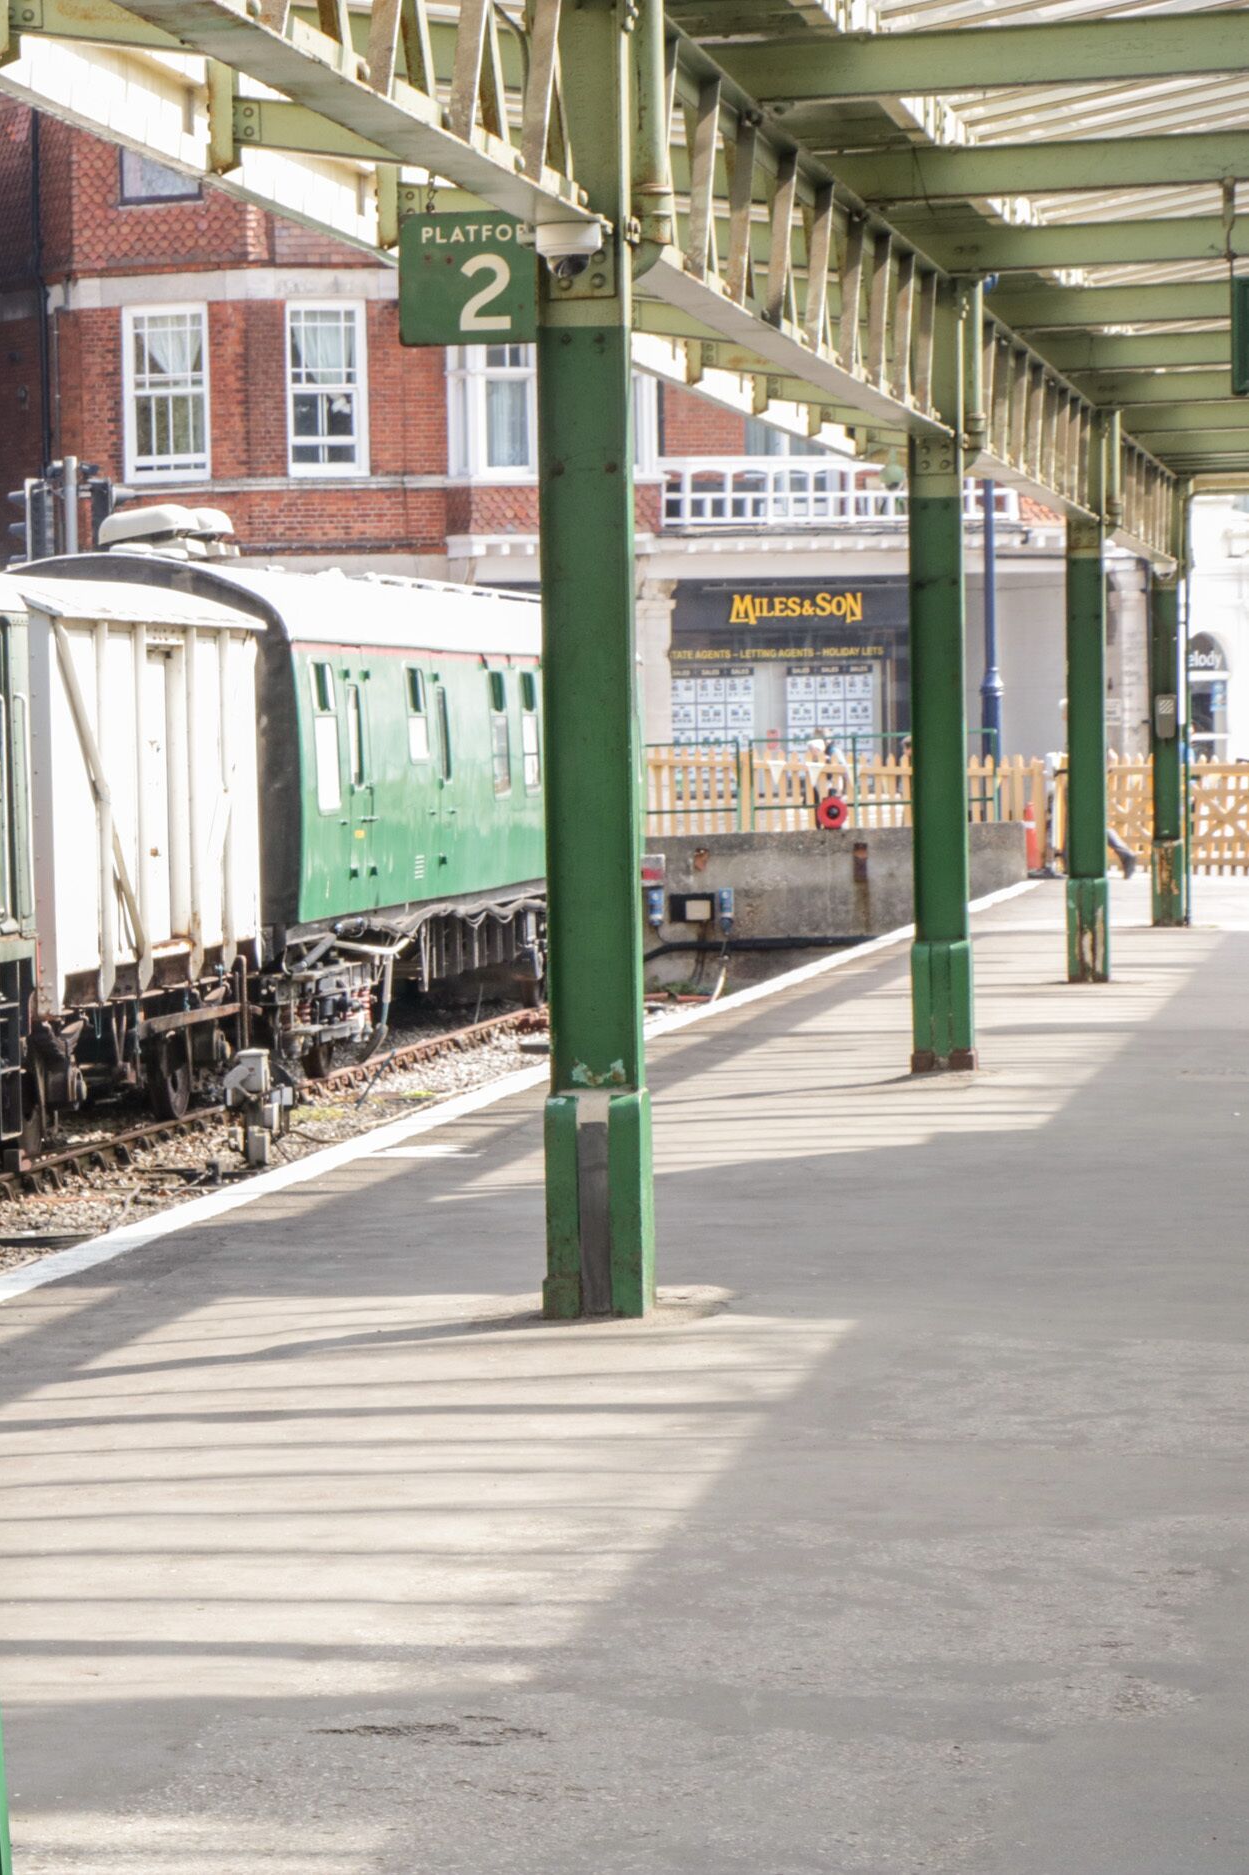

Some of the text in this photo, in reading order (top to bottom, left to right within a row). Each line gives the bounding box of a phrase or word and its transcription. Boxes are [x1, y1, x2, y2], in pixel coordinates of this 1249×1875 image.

[420, 223, 526, 244] PLATFO
[459, 253, 512, 332] 2
[728, 591, 863, 625] MILES&SON
[670, 650, 693, 660] TATE
[695, 649, 731, 660] AGENTS
[740, 648, 776, 659] LETTING
[778, 647, 814, 658] AGENTS
[822, 646, 860, 657] HOLIDAY
[862, 646, 884, 656] LETS
[1188, 649, 1222, 669] elody
